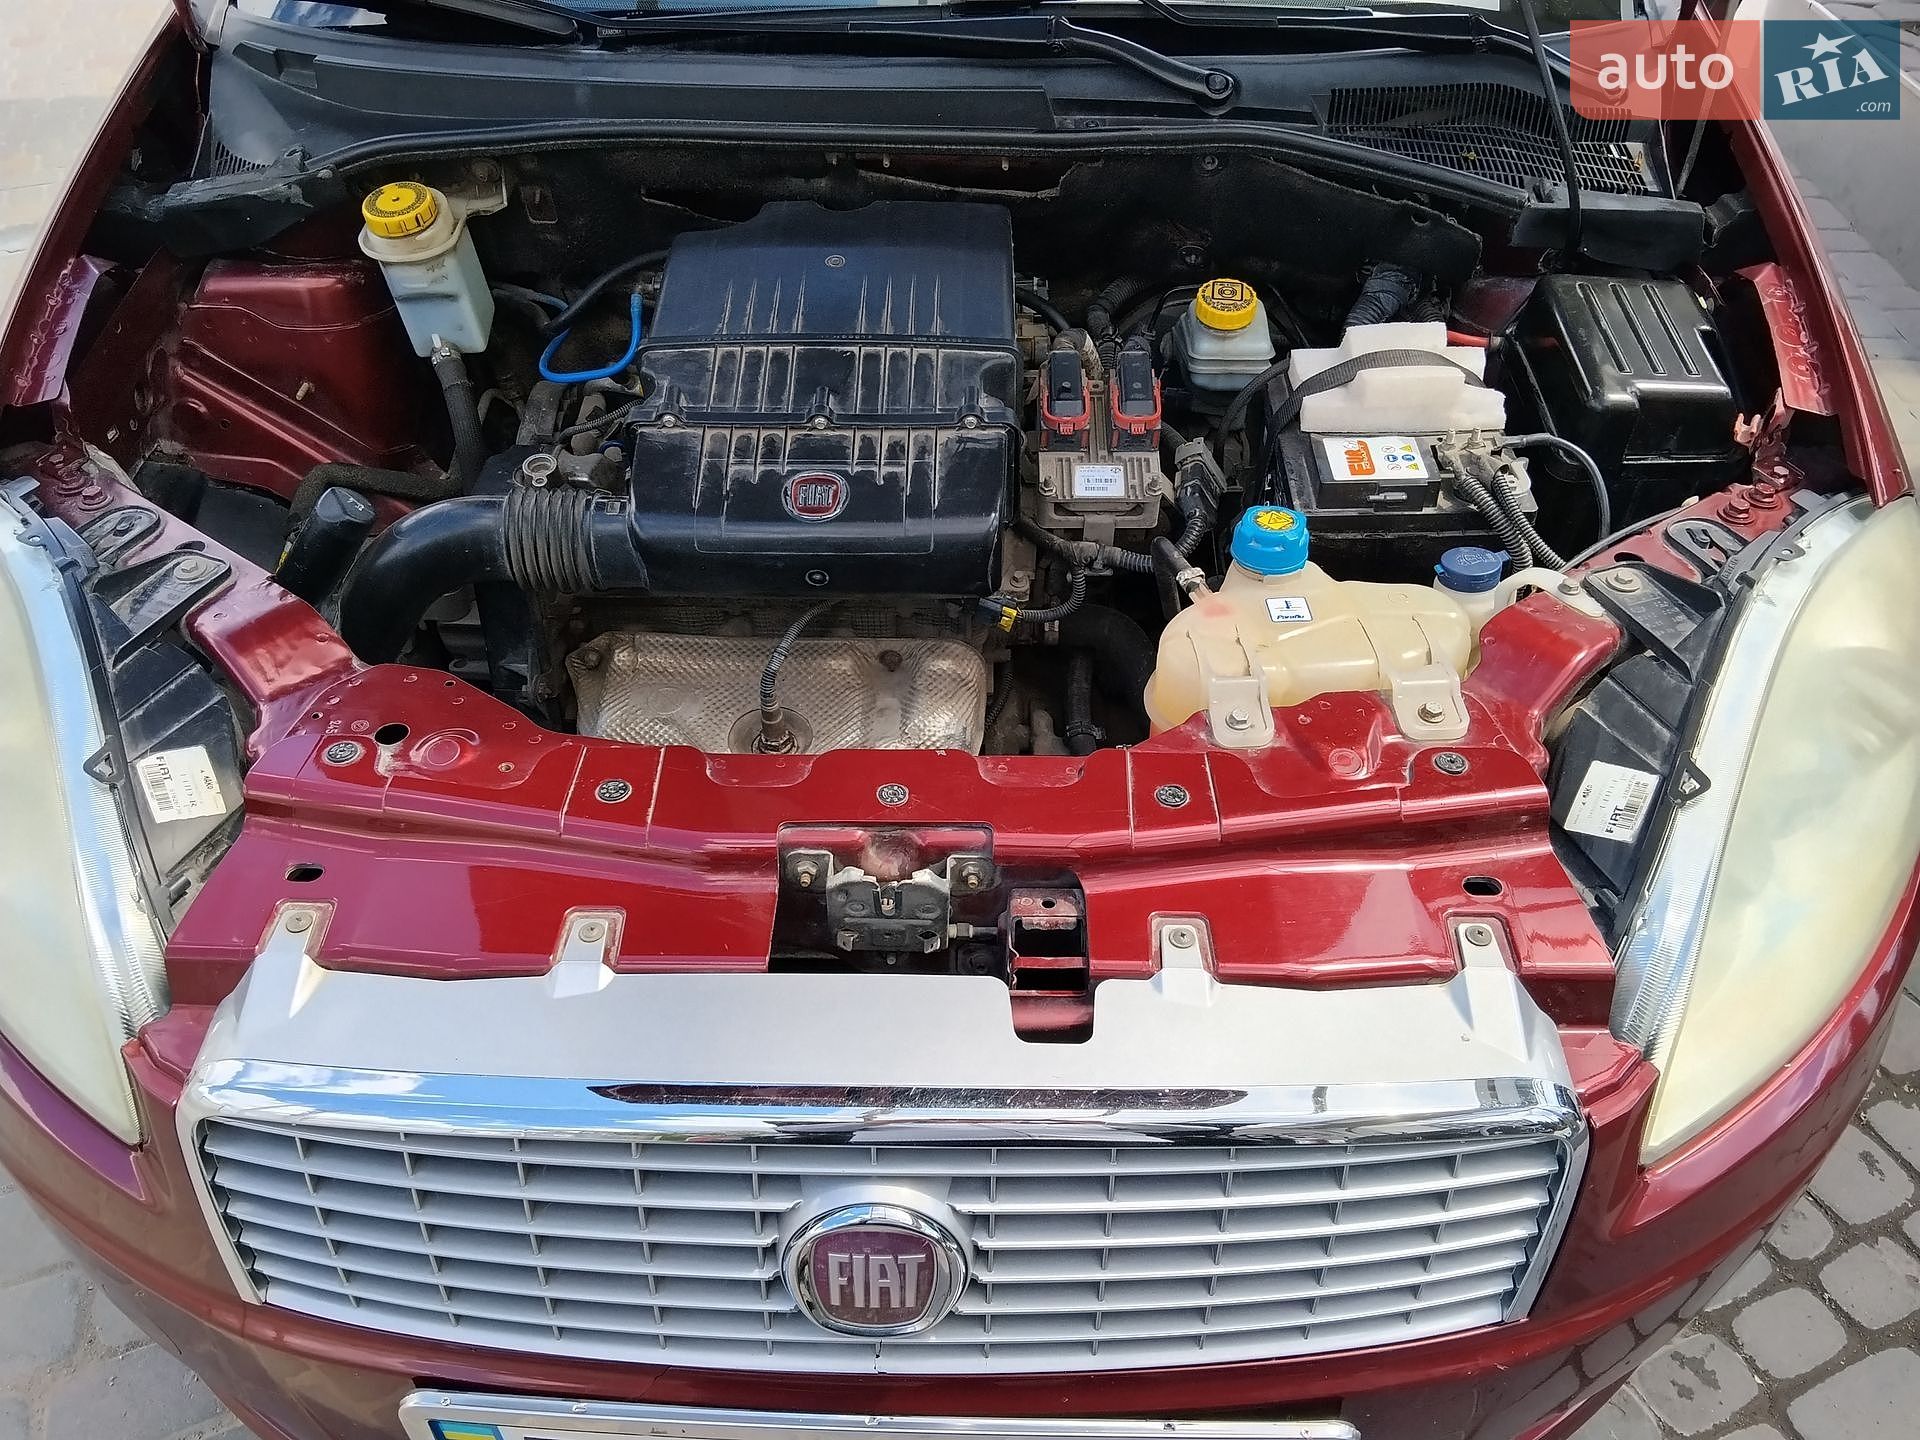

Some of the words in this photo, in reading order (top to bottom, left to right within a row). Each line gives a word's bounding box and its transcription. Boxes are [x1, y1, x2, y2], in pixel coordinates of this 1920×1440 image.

[798, 484, 836, 507] FIAT
[156, 755, 173, 782] FIAT
[1604, 804, 1624, 834] FIAT
[828, 1252, 926, 1309] FIAT
